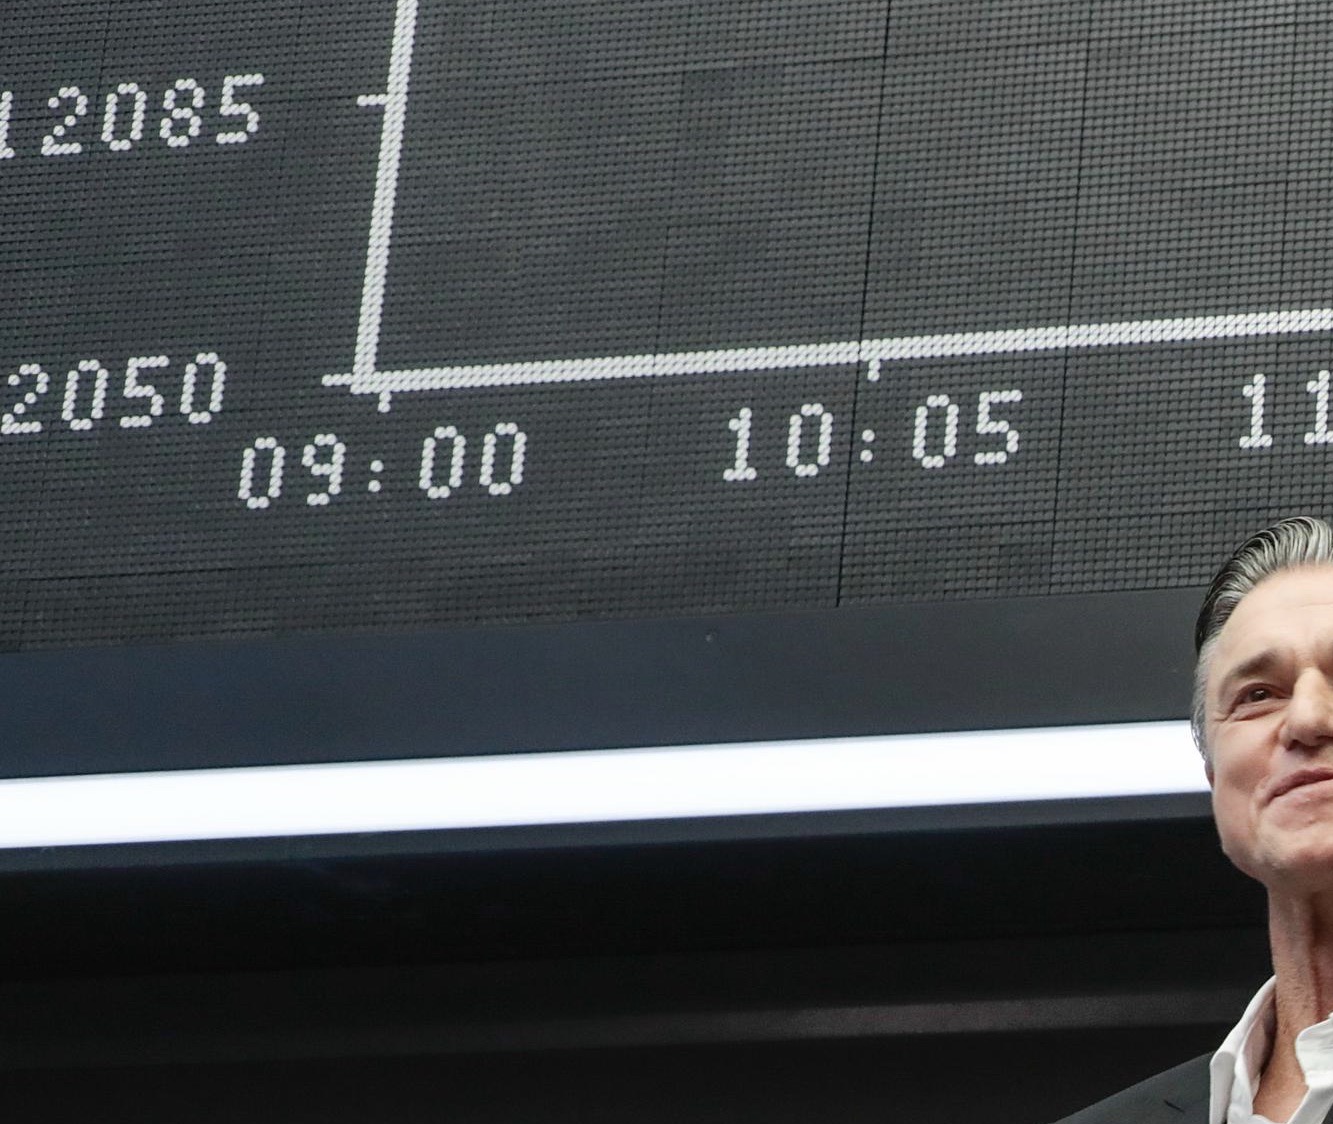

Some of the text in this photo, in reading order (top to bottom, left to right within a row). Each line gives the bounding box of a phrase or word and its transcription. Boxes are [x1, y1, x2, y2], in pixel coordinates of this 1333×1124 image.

[0, 74, 263, 158] 12085
[1, 352, 226, 434] 2050
[239, 423, 526, 508] 09:00
[724, 390, 1022, 480] 10:05
